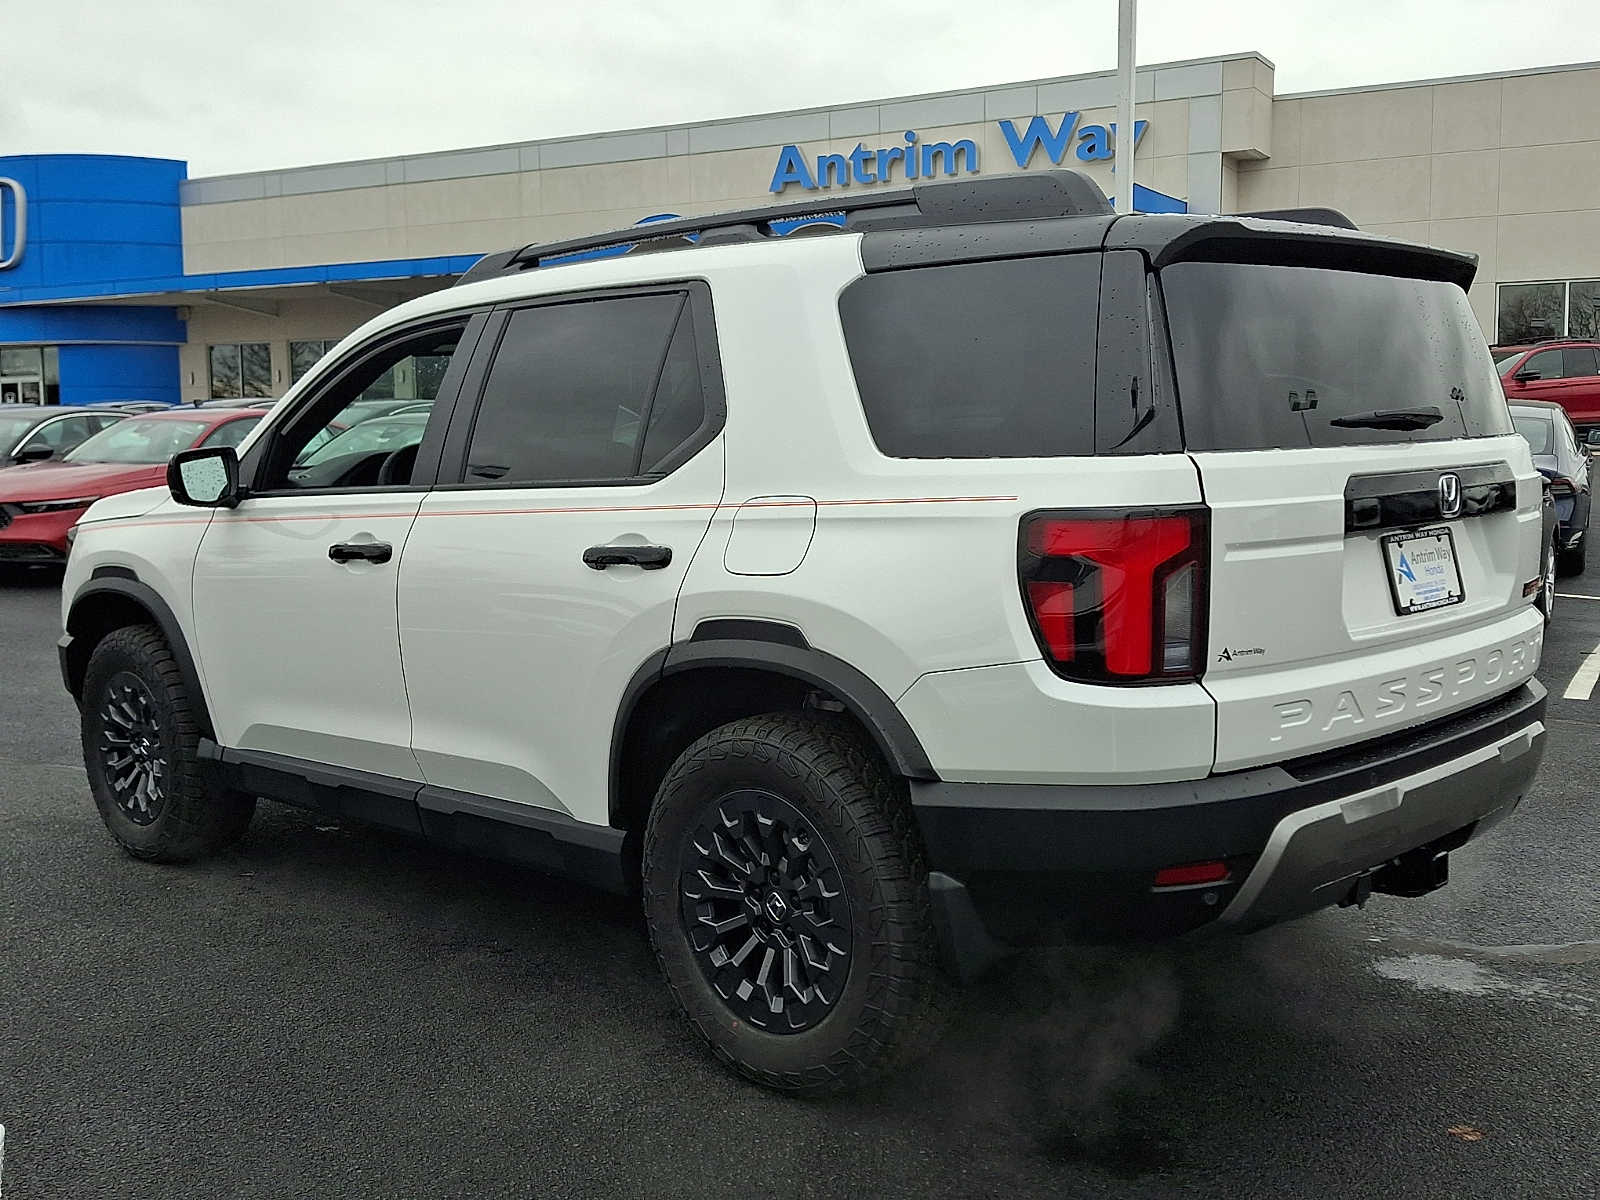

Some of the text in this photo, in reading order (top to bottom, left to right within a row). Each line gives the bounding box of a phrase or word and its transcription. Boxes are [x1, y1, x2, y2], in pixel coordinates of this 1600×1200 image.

[769, 111, 1149, 193] Antrim Wa
[1390, 532, 1415, 542] ANTRIM
[1415, 530, 1428, 538] WAY
[1411, 546, 1451, 565] Antrim Way
[1270, 631, 1541, 742] PASSPORT
